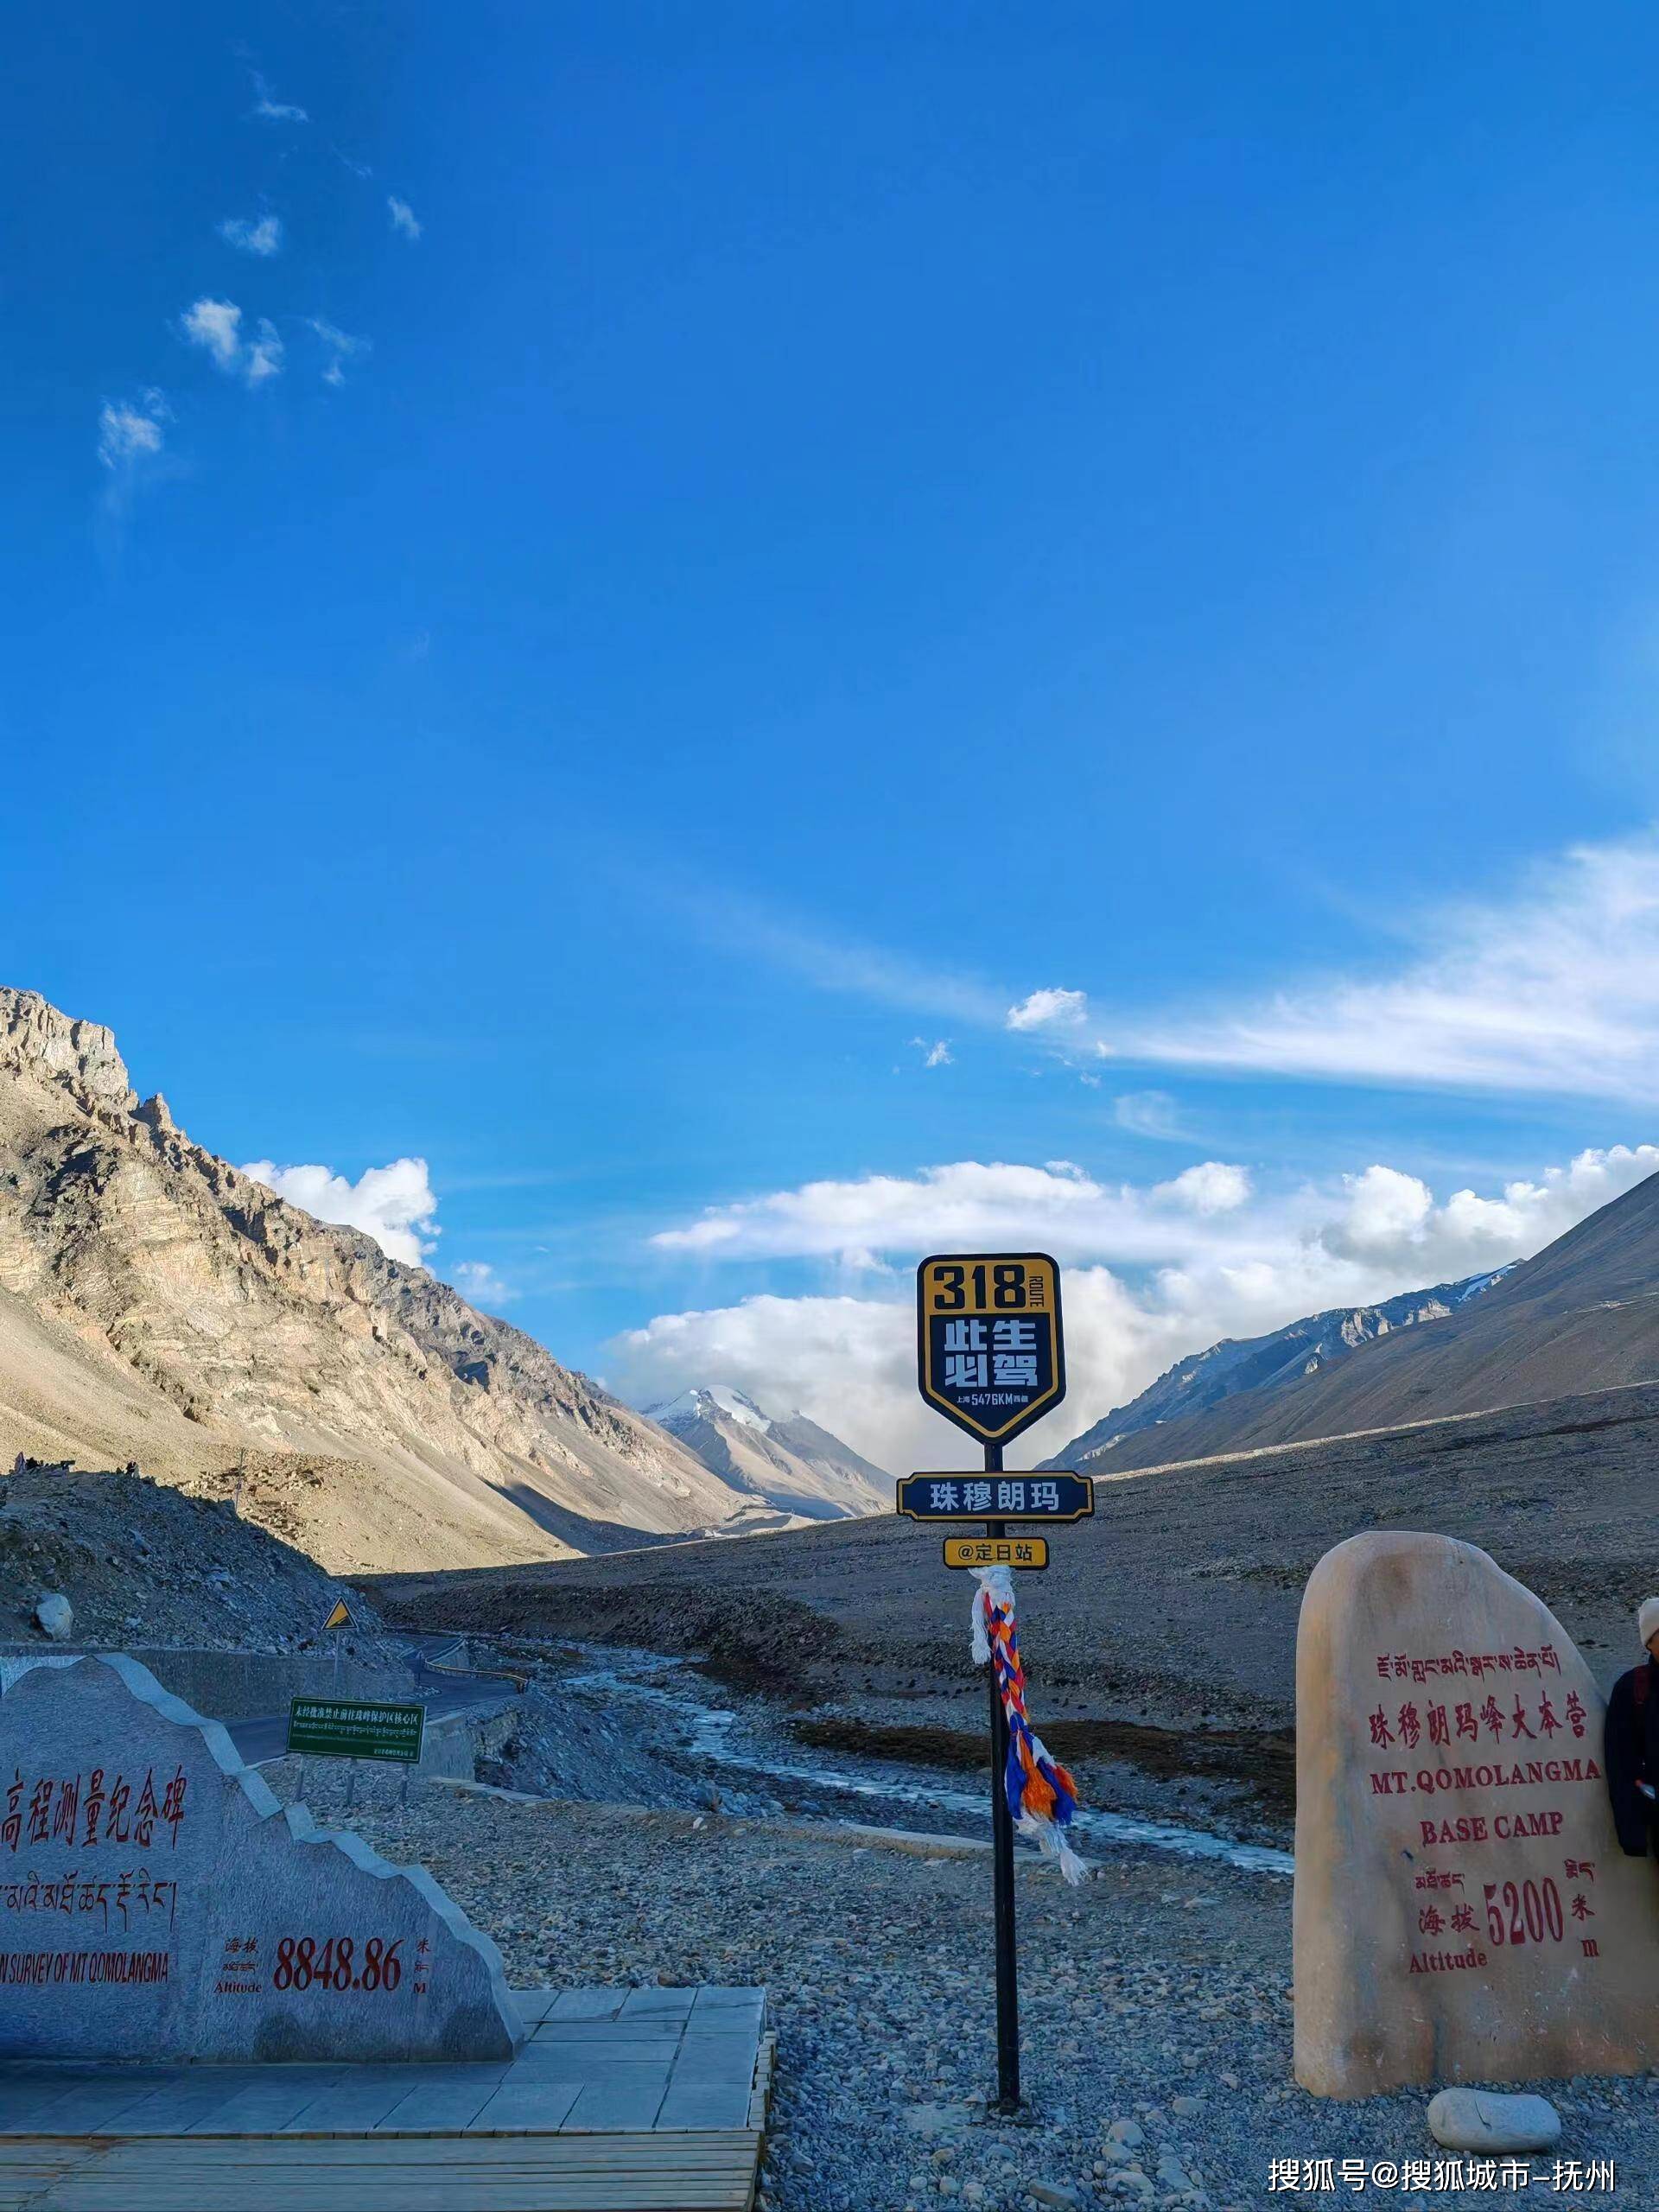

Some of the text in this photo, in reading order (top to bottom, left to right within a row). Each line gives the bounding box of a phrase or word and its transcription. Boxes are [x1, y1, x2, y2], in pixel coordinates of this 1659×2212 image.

[933, 1264, 1027, 1309] 318
[1028, 1275, 1044, 1307] ROUTE
[944, 1319, 1037, 1351] 此生
[944, 1354, 1038, 1388] 必驾
[971, 1393, 1014, 1406] 5476KM
[930, 1482, 1059, 1512] 珠穆朗玛
[957, 1543, 1033, 1562] @定日站
[1369, 1690, 1587, 1750] 珠穆朗玛峰大本营
[1, 1764, 188, 1853] 高程测量纪念碑
[1420, 1811, 1564, 1847] BASE CAMP
[1418, 1877, 1596, 1946] 海拔 5200 米
[1409, 1948, 1488, 1974] Altitude
[1580, 1938, 1599, 1957] m
[10, 1953, 54, 1984] SURVEY
[54, 1953, 69, 1984] OF
[69, 1952, 89, 1984] MT
[88, 1952, 169, 1984] QOMOLANGMA
[224, 1938, 258, 1954] 海拔
[273, 1937, 404, 1991] 8848.86
[213, 1980, 262, 1994] Altitude
[414, 1982, 427, 1994] M
